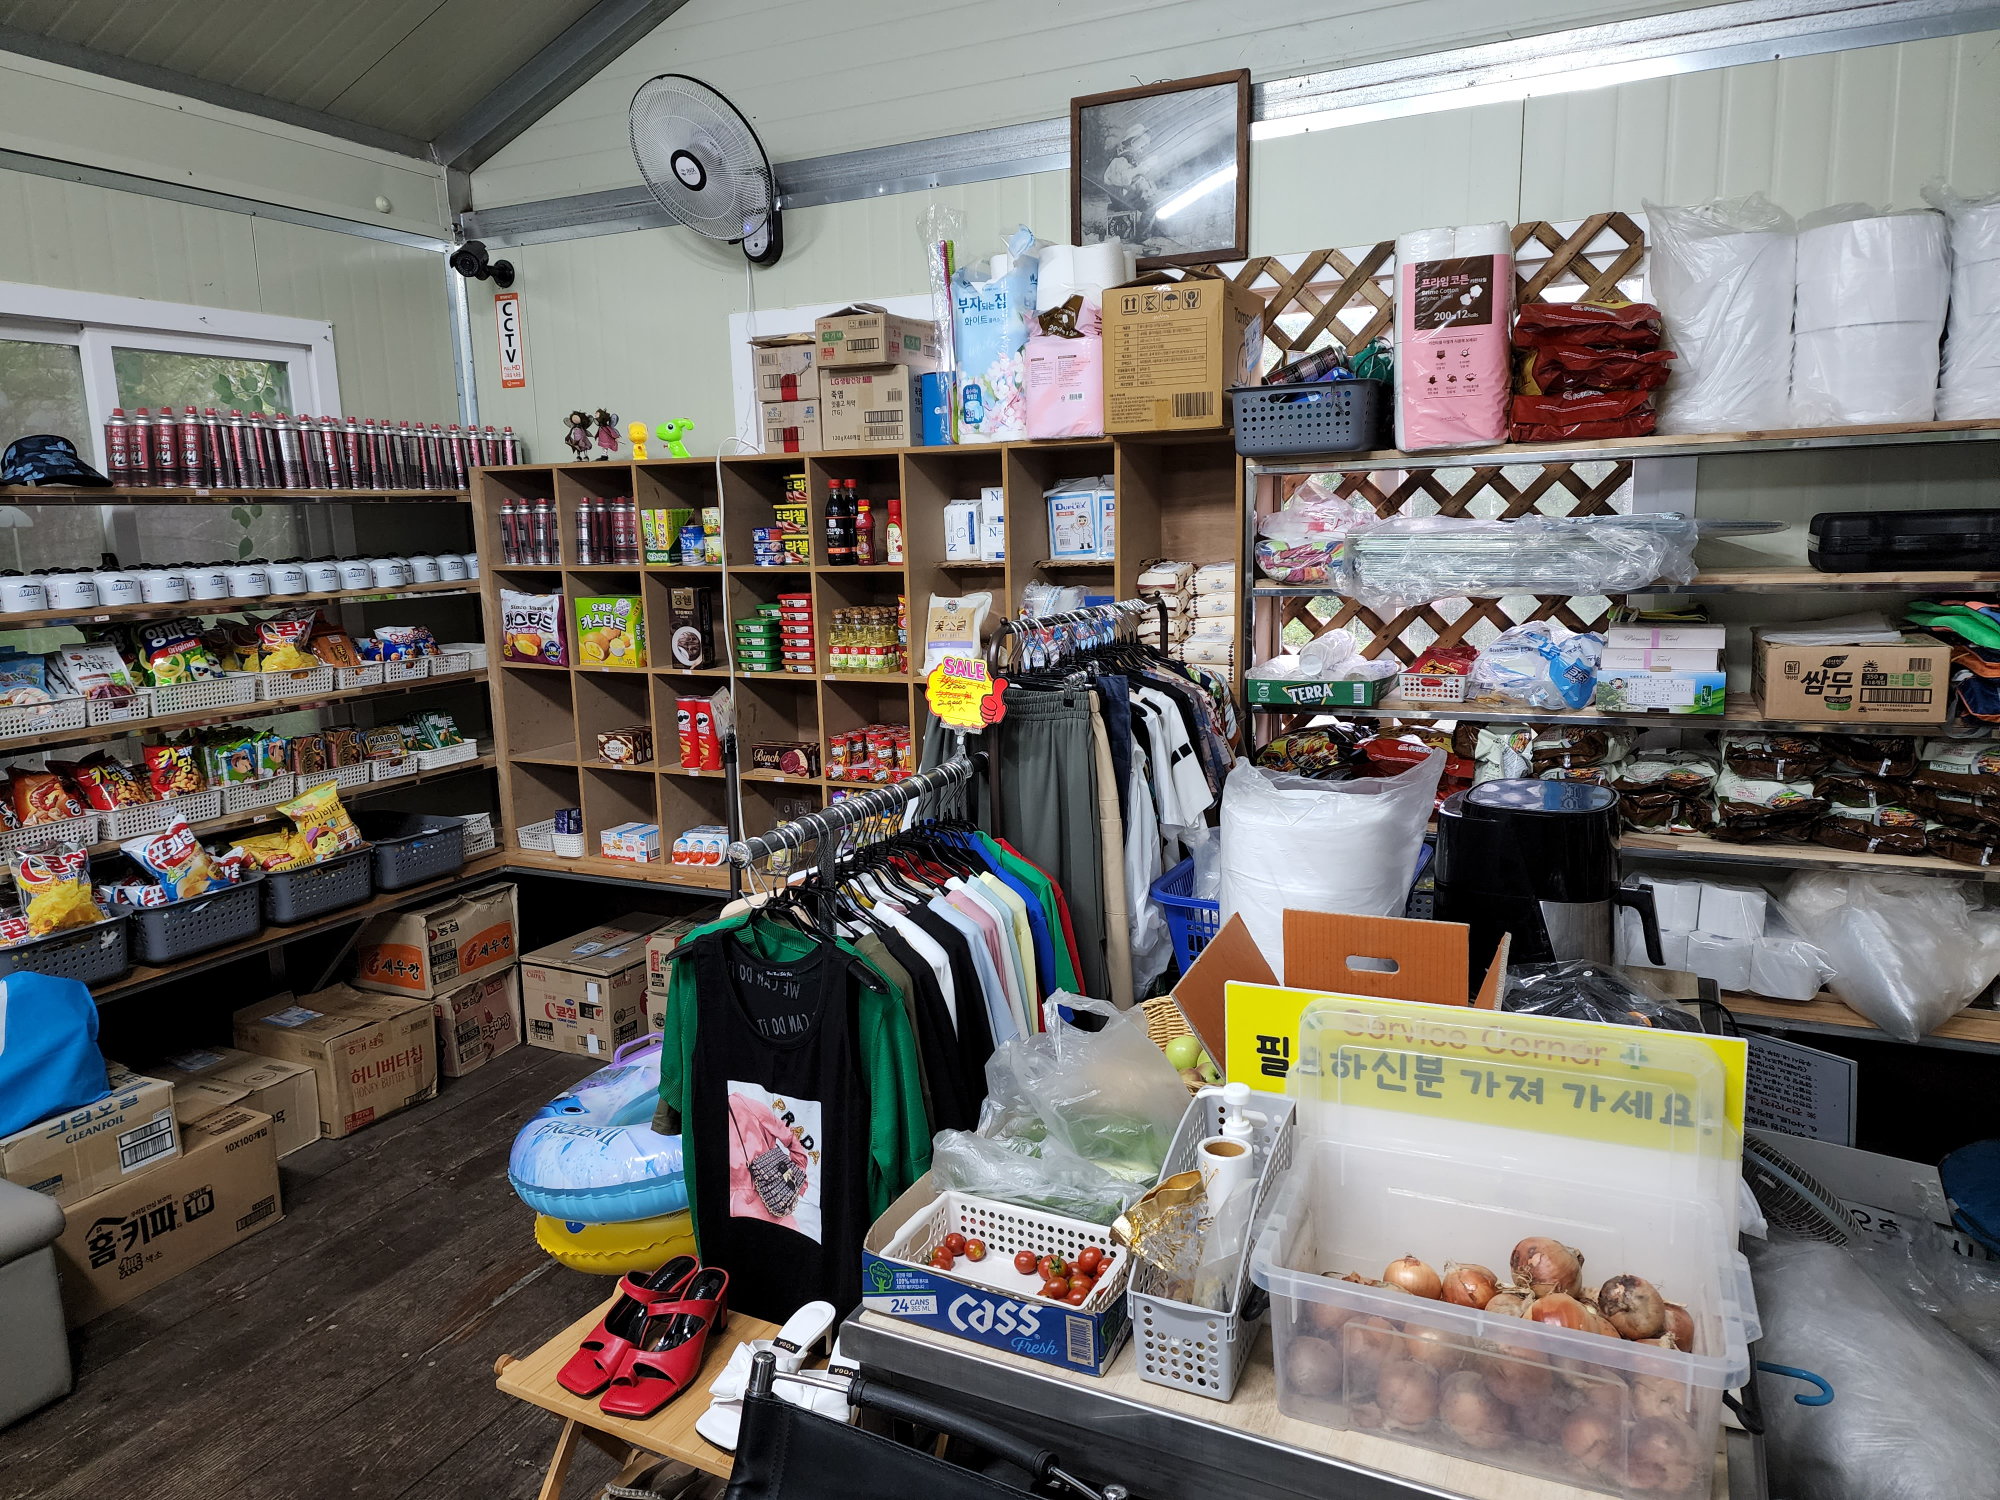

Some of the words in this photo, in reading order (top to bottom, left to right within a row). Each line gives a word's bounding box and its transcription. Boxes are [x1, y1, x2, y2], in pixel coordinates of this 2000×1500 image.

[1421, 276, 1449, 288] 프라임
[1450, 274, 1470, 286] 코튼
[964, 315, 988, 326] 화이트
[502, 301, 517, 364] CCTV
[782, 510, 806, 522] 리챔
[785, 540, 808, 554] 리챔
[348, 569, 366, 578] MAX
[20, 588, 41, 596] MAX
[112, 583, 133, 591] MAX
[166, 580, 184, 588] MAX
[591, 604, 612, 612] 오리온
[504, 612, 555, 632] 카스타드
[580, 615, 626, 632] 카스타드
[934, 620, 967, 632] 꽃소금
[168, 640, 196, 654] Original
[944, 657, 986, 682] SALE
[1800, 669, 1854, 695] 쌈무
[1288, 684, 1334, 702] TERRA
[370, 733, 398, 744] HARIBO
[754, 748, 780, 763] Binch
[150, 827, 196, 864] 포카칩
[438, 922, 460, 936] 농심
[478, 934, 510, 957] 새우깡
[381, 962, 420, 980] 새우깡
[556, 1005, 577, 1020] 콘칩
[1343, 1008, 1468, 1050] Service
[1481, 1025, 1608, 1067] Corner
[350, 1044, 423, 1084] 허니버터칩
[354, 1082, 379, 1099] HONEY
[381, 1072, 406, 1088] BUTTER
[1460, 1069, 1544, 1104] 가져
[1760, 1097, 1802, 1116] 전기안전
[65, 1124, 100, 1144] CLEAN
[100, 1114, 126, 1132] FOIL
[534, 1120, 604, 1139] FROZEN
[772, 1097, 820, 1165] PRADA
[224, 1126, 268, 1154] 10X100개입
[186, 1193, 210, 1217] 10
[890, 1298, 909, 1313] 24
[1011, 1336, 1058, 1356] Fresh
